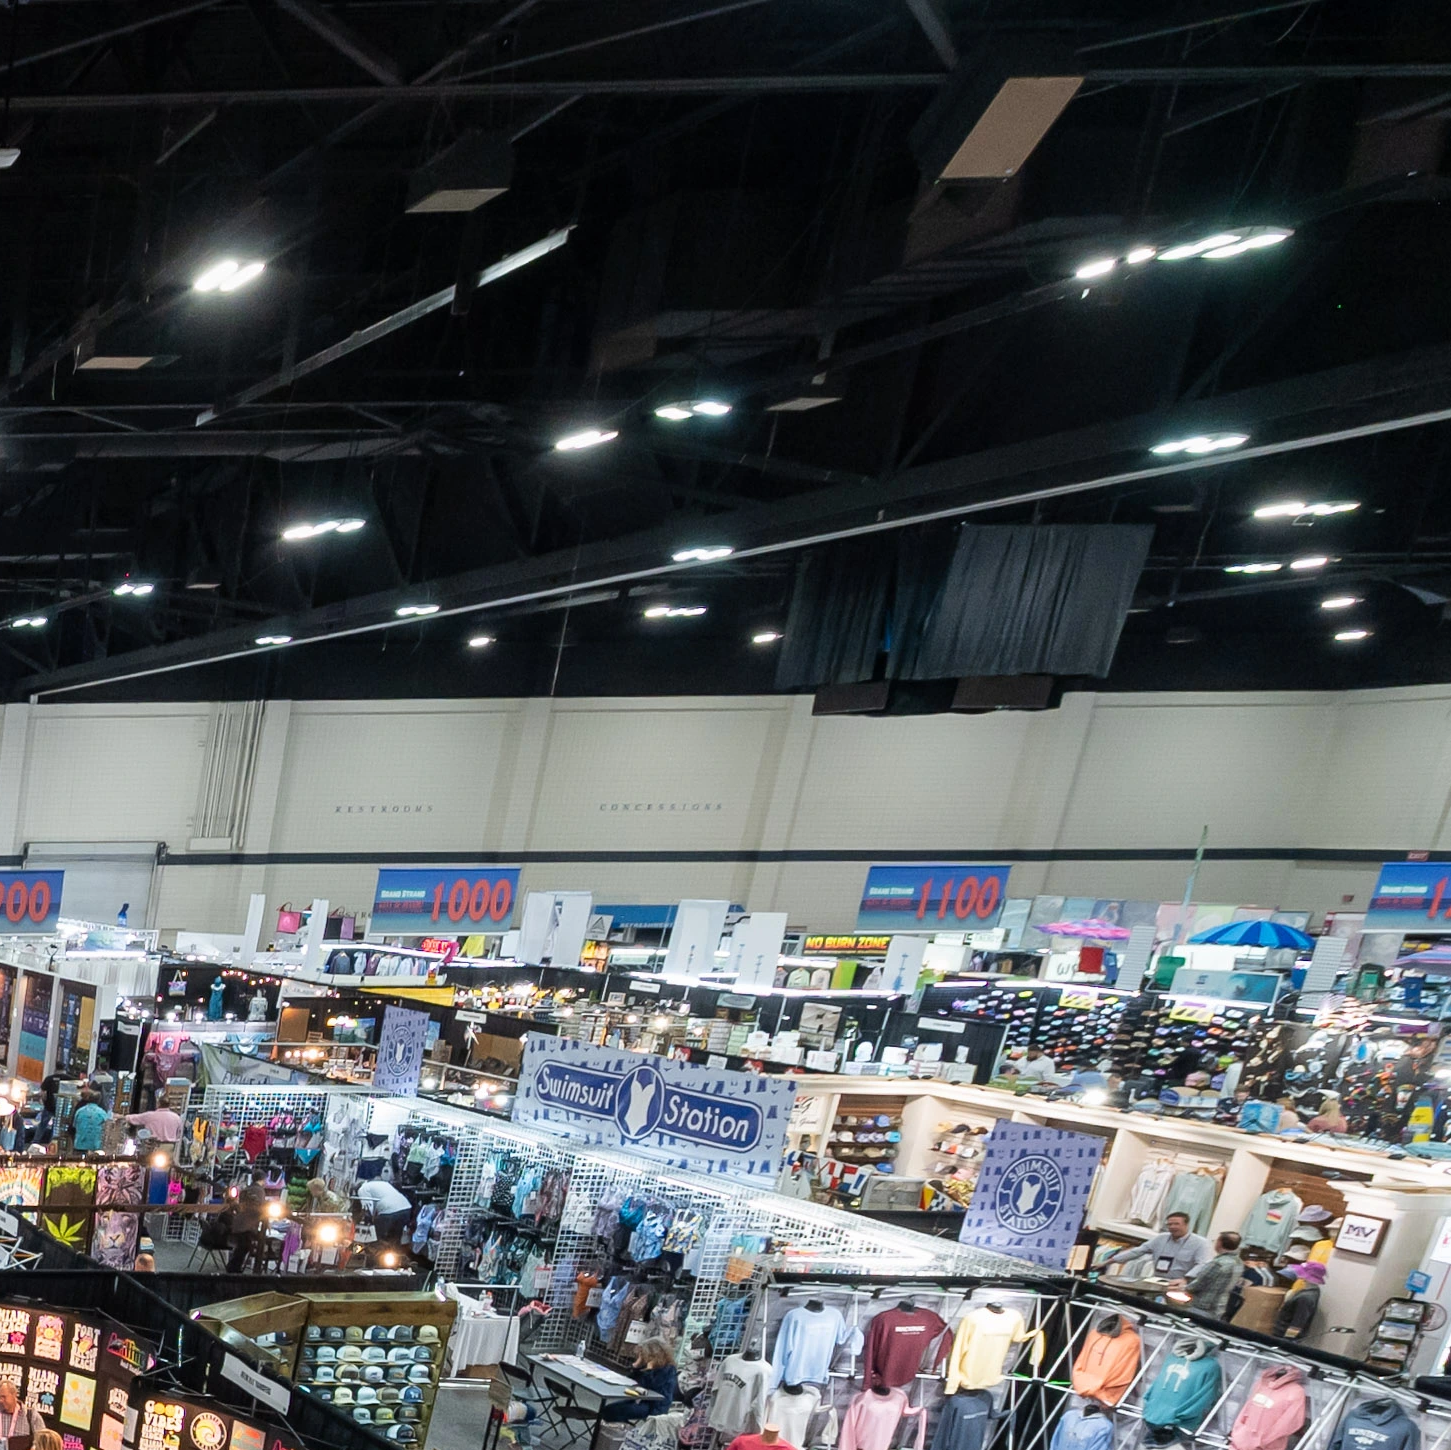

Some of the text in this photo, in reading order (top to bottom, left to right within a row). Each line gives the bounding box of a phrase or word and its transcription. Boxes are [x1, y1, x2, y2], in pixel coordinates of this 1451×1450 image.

[334, 805, 434, 813] RESTROOMS
[599, 803, 723, 812] CONCESSIONS
[431, 878, 513, 923] 1000
[916, 876, 1000, 920] 1100
[805, 936, 889, 950] NO BURN ZONE
[537, 1065, 750, 1141] Swimsuit Station
[1008, 1160, 1060, 1194] SWIMSUIT
[998, 1203, 1048, 1231] STATION
[1344, 1224, 1377, 1239] MV
